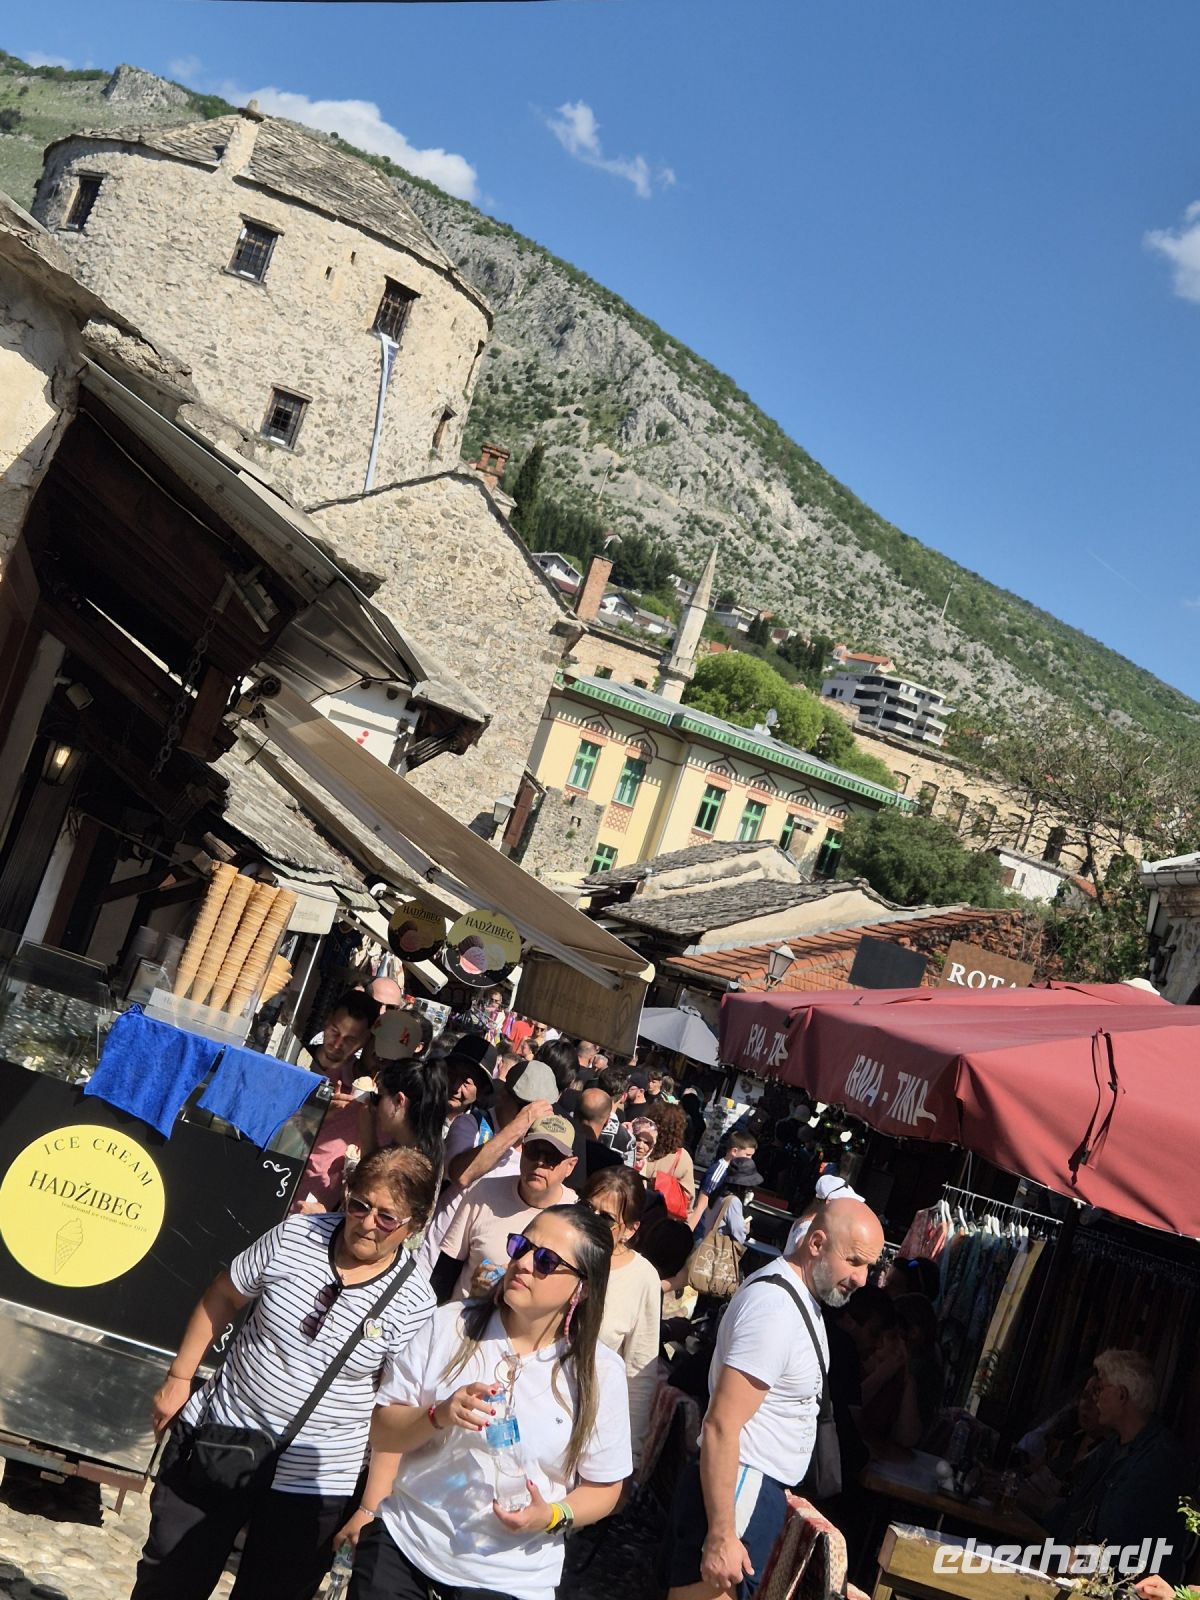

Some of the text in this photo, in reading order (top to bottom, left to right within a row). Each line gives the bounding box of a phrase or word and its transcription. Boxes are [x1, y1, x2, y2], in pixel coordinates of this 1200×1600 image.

[402, 905, 441, 922] HADŽIBEG
[466, 917, 515, 941] HADŽIBEG
[947, 962, 1016, 988] ROT
[845, 1054, 885, 1108] IRMA
[44, 1136, 153, 1187] ICE CREAM
[28, 1169, 143, 1221] HADŽIBEG
